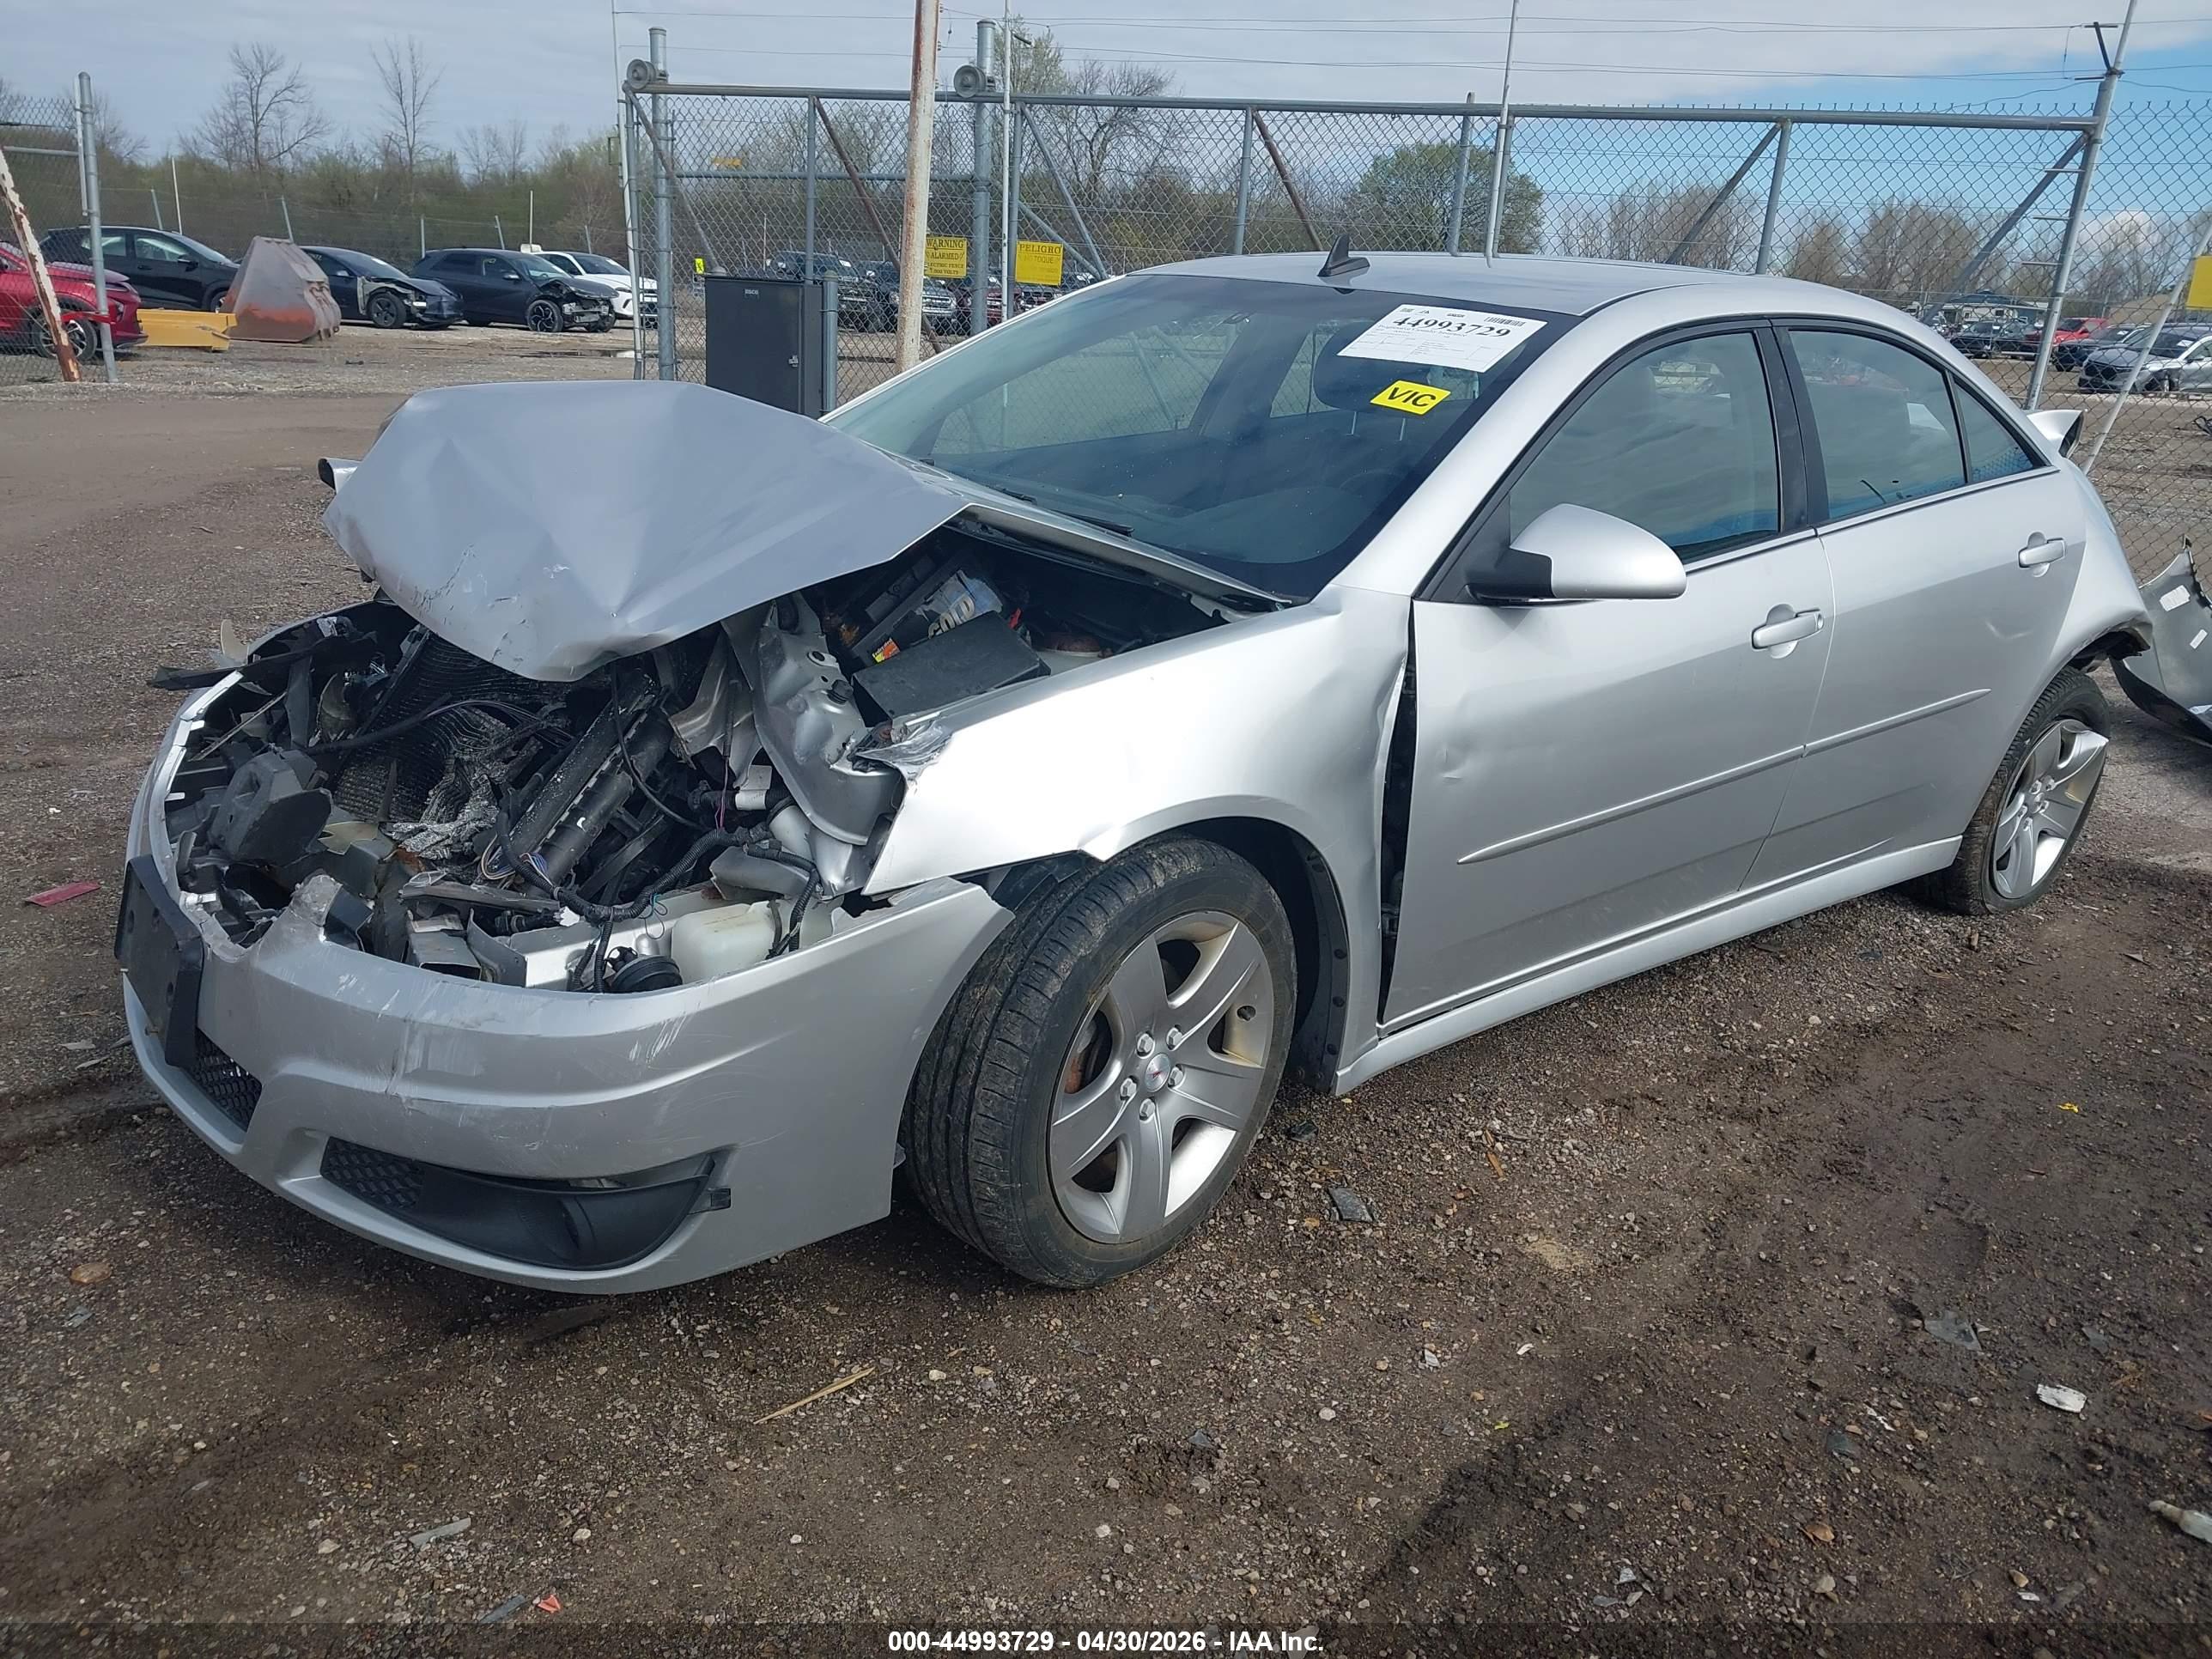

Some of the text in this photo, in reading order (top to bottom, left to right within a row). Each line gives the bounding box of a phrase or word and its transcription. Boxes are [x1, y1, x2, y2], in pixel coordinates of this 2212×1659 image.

[926, 239, 963, 248] WARNING
[1019, 244, 1061, 254] PELIGRO
[931, 252, 959, 260] ALARMED
[1034, 255, 1054, 264] TOQUE
[1393, 317, 1511, 337] 44993729
[1388, 386, 1437, 407] VIC
[928, 595, 975, 639] GOLD
